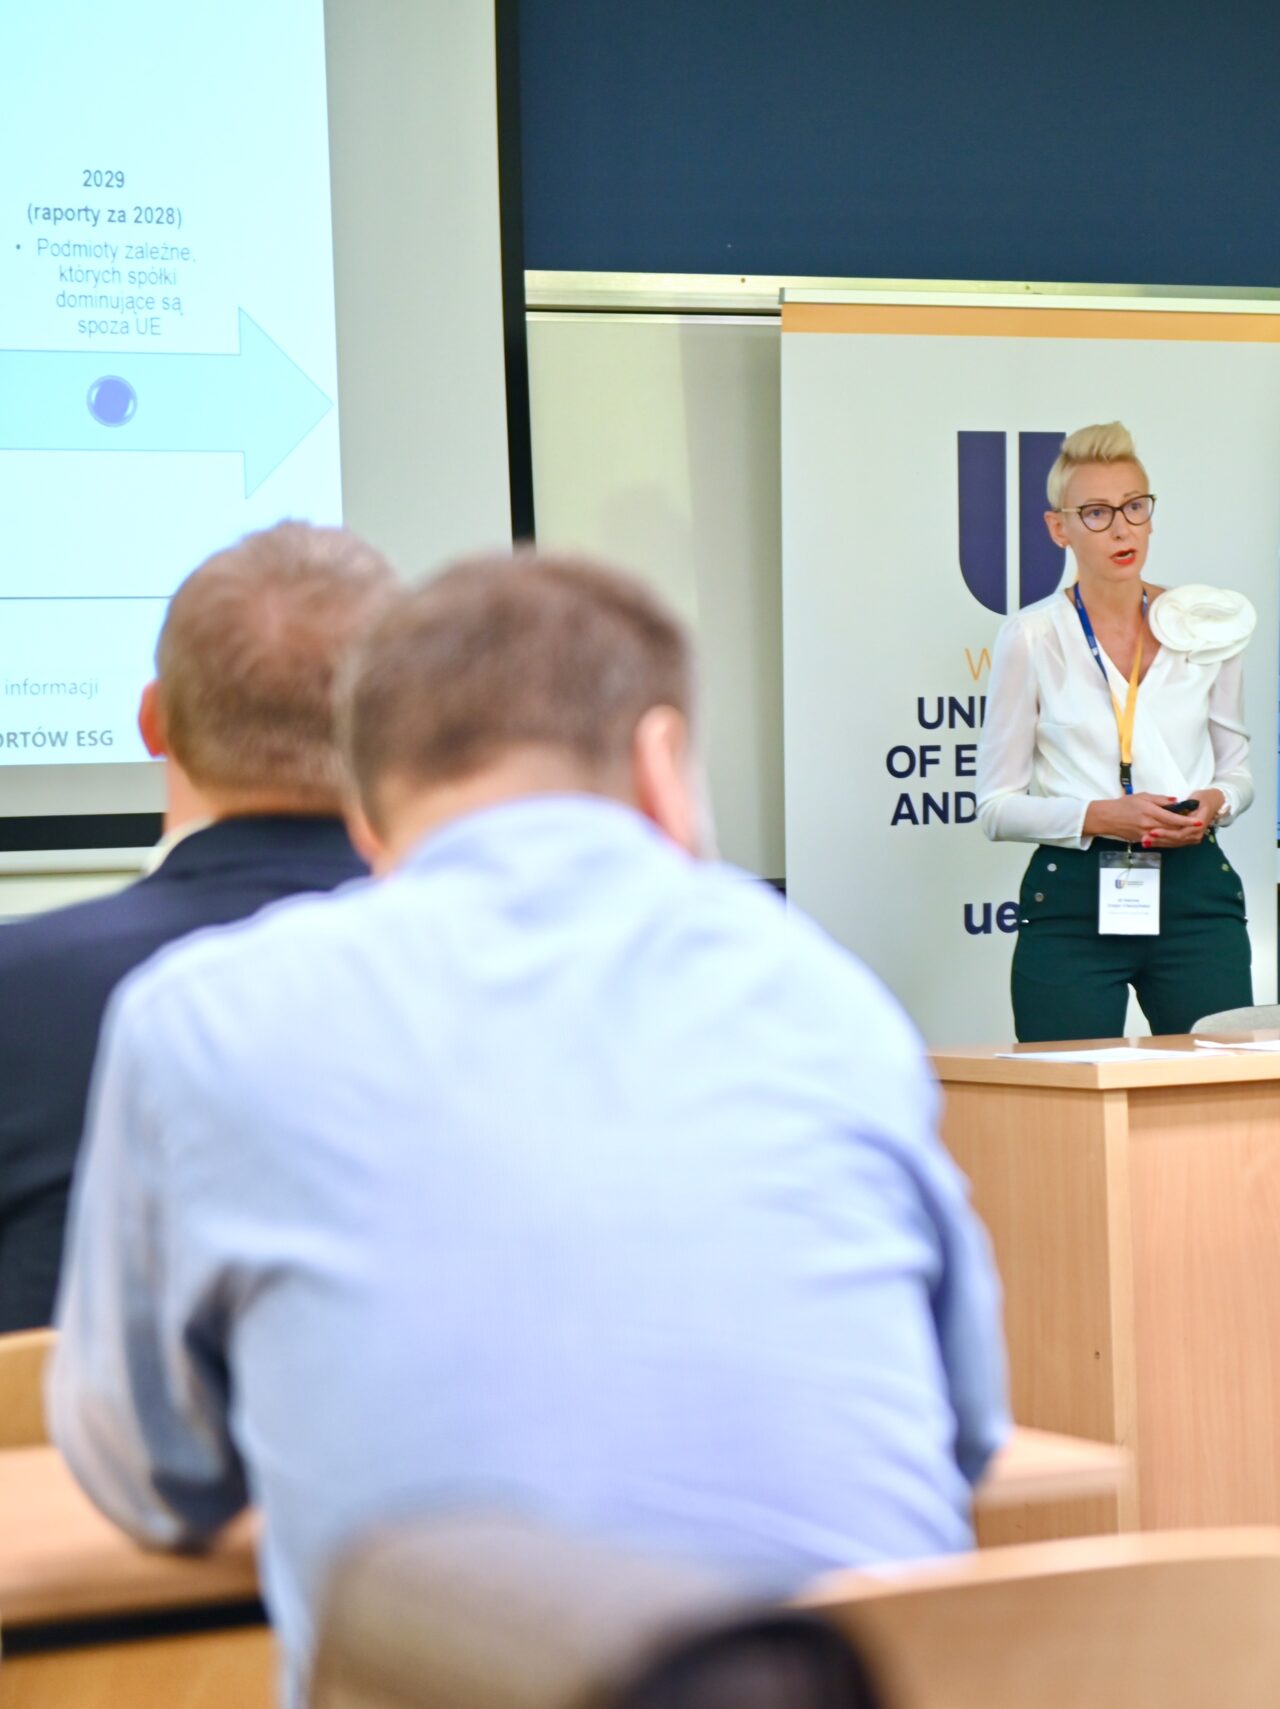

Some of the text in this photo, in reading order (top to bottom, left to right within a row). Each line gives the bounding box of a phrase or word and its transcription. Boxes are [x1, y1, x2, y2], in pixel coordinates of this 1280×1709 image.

[82, 169, 125, 188] 2029
[27, 203, 182, 229] (raporty za 2028)
[37, 238, 197, 263] Podmioty zależne,
[59, 265, 177, 288] których spółki
[56, 290, 184, 316] dominujące są
[78, 317, 162, 338] spoza UE
[5, 678, 99, 699] informacji
[77, 730, 114, 747] ESG
[886, 745, 941, 779] OF
[890, 791, 977, 826] AND
